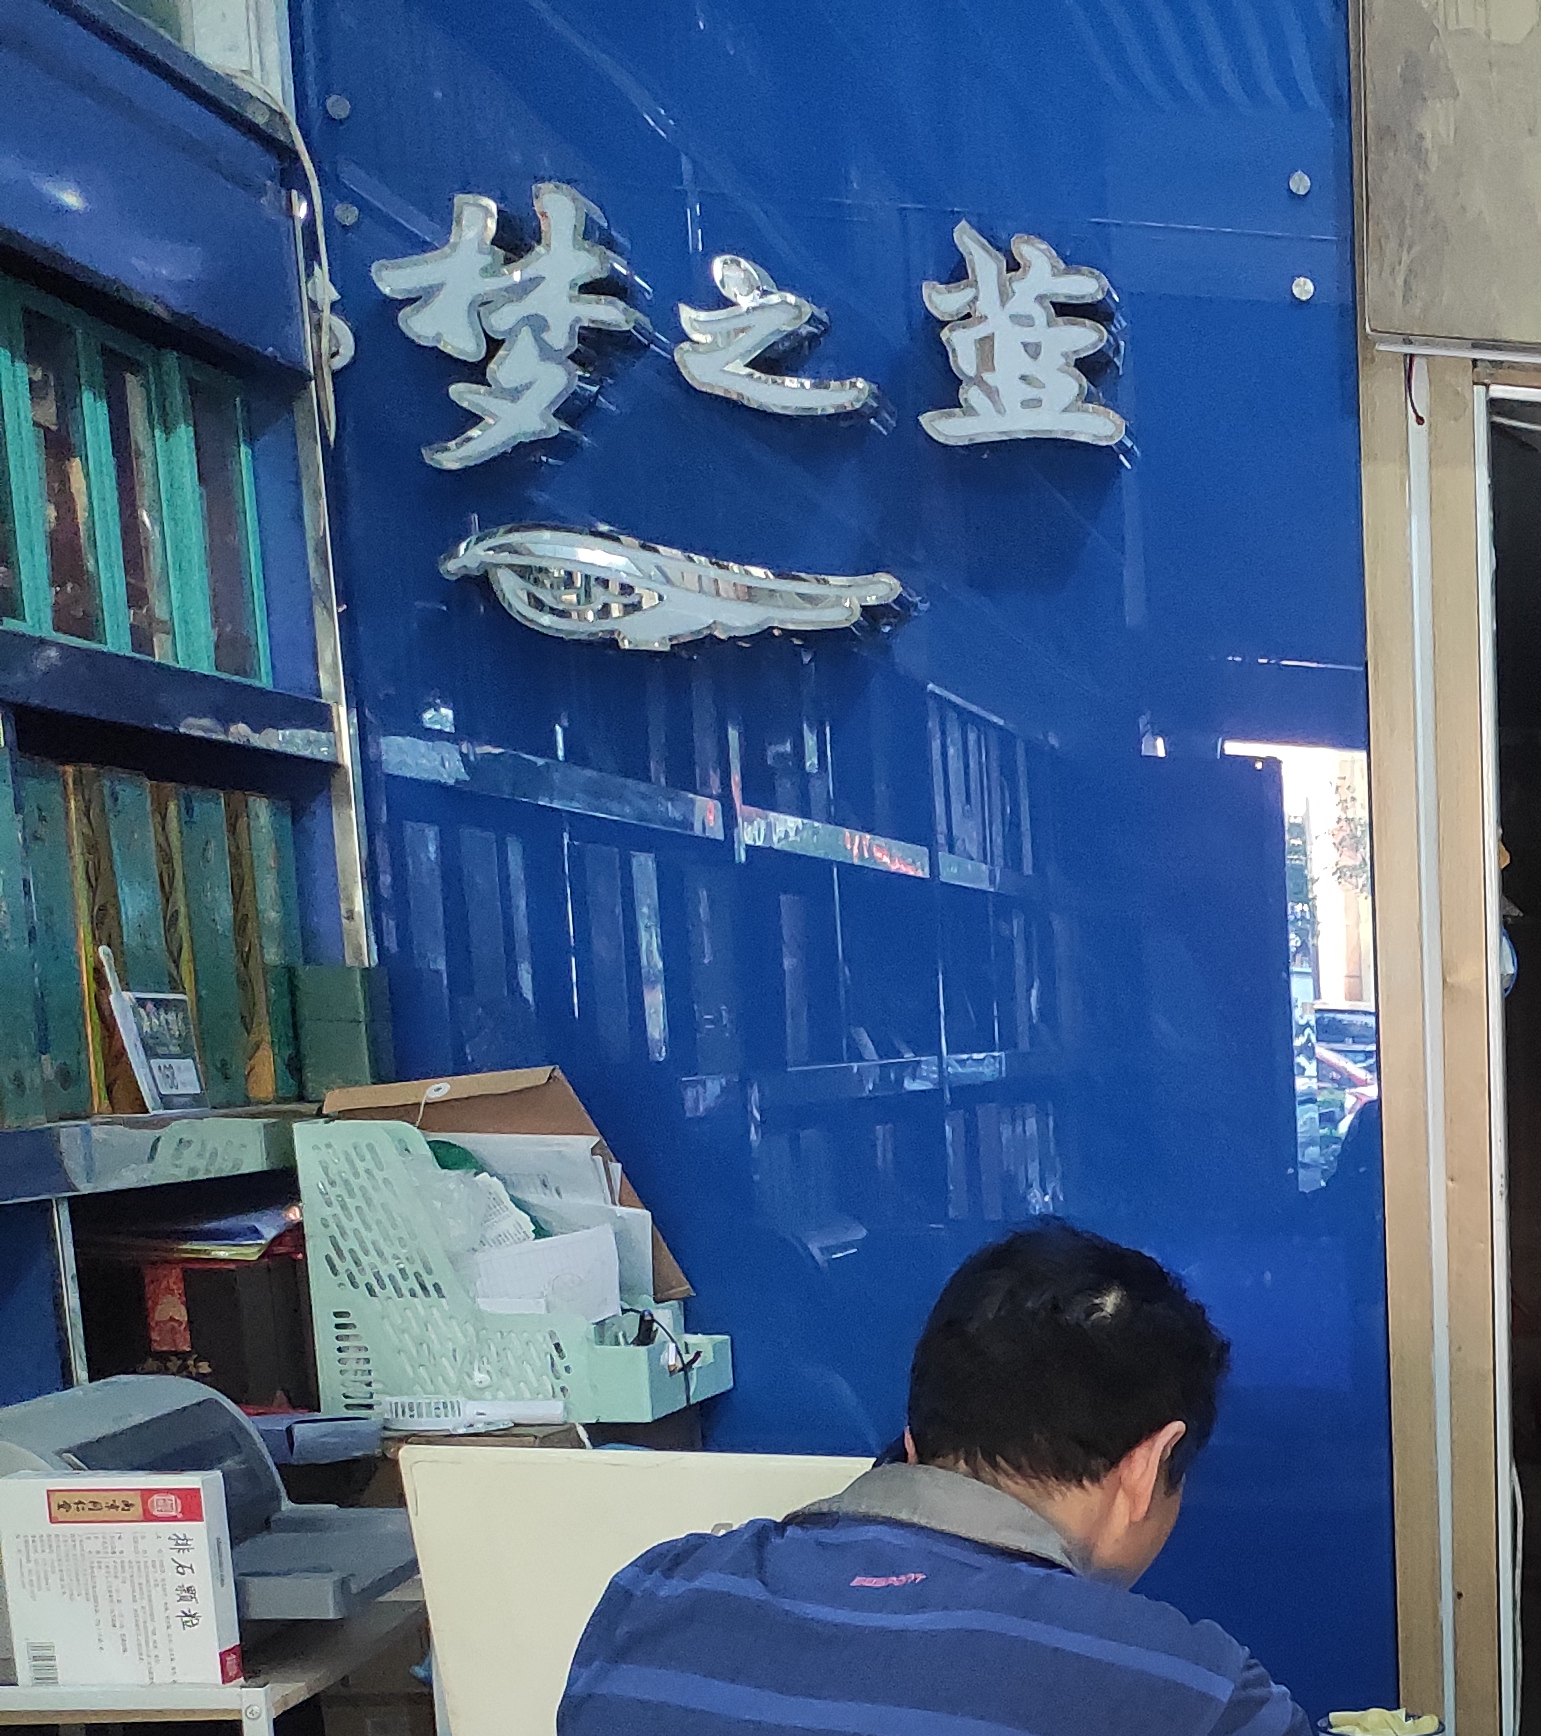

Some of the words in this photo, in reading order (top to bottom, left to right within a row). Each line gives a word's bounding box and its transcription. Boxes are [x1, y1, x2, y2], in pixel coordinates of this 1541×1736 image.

[371, 181, 1127, 470] 梦之蓝
[167, 1532, 203, 1631] 排石颗粒
